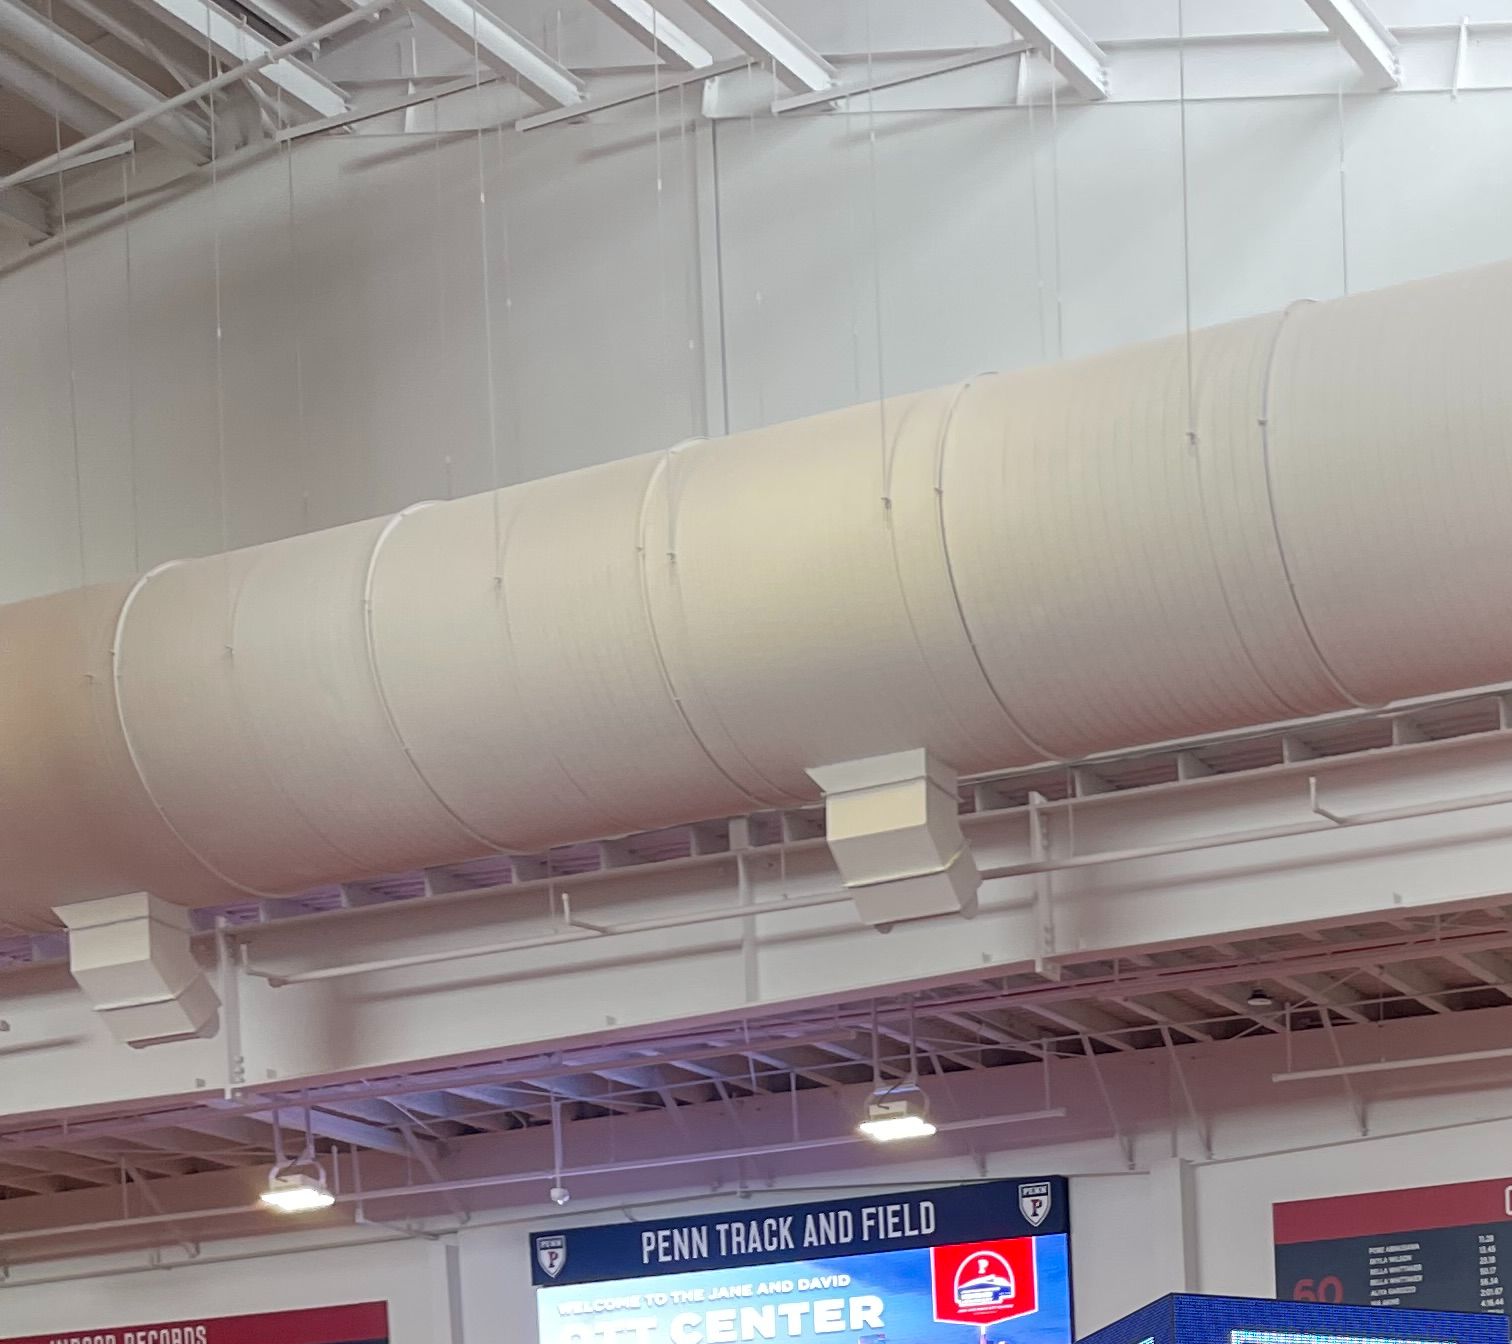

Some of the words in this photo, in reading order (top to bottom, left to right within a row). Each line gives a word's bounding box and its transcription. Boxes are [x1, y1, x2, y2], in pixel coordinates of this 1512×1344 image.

[642, 1225, 709, 1264] PENN
[716, 1217, 795, 1253] TRACK
[804, 1210, 852, 1247] AND
[861, 1201, 936, 1241] FIELD
[557, 1295, 641, 1316] WELCOME
[644, 1292, 668, 1308] TO
[670, 1288, 706, 1305] THE
[708, 1283, 753, 1301] JANE
[756, 1279, 794, 1297] AND
[797, 1273, 852, 1292] DAVID
